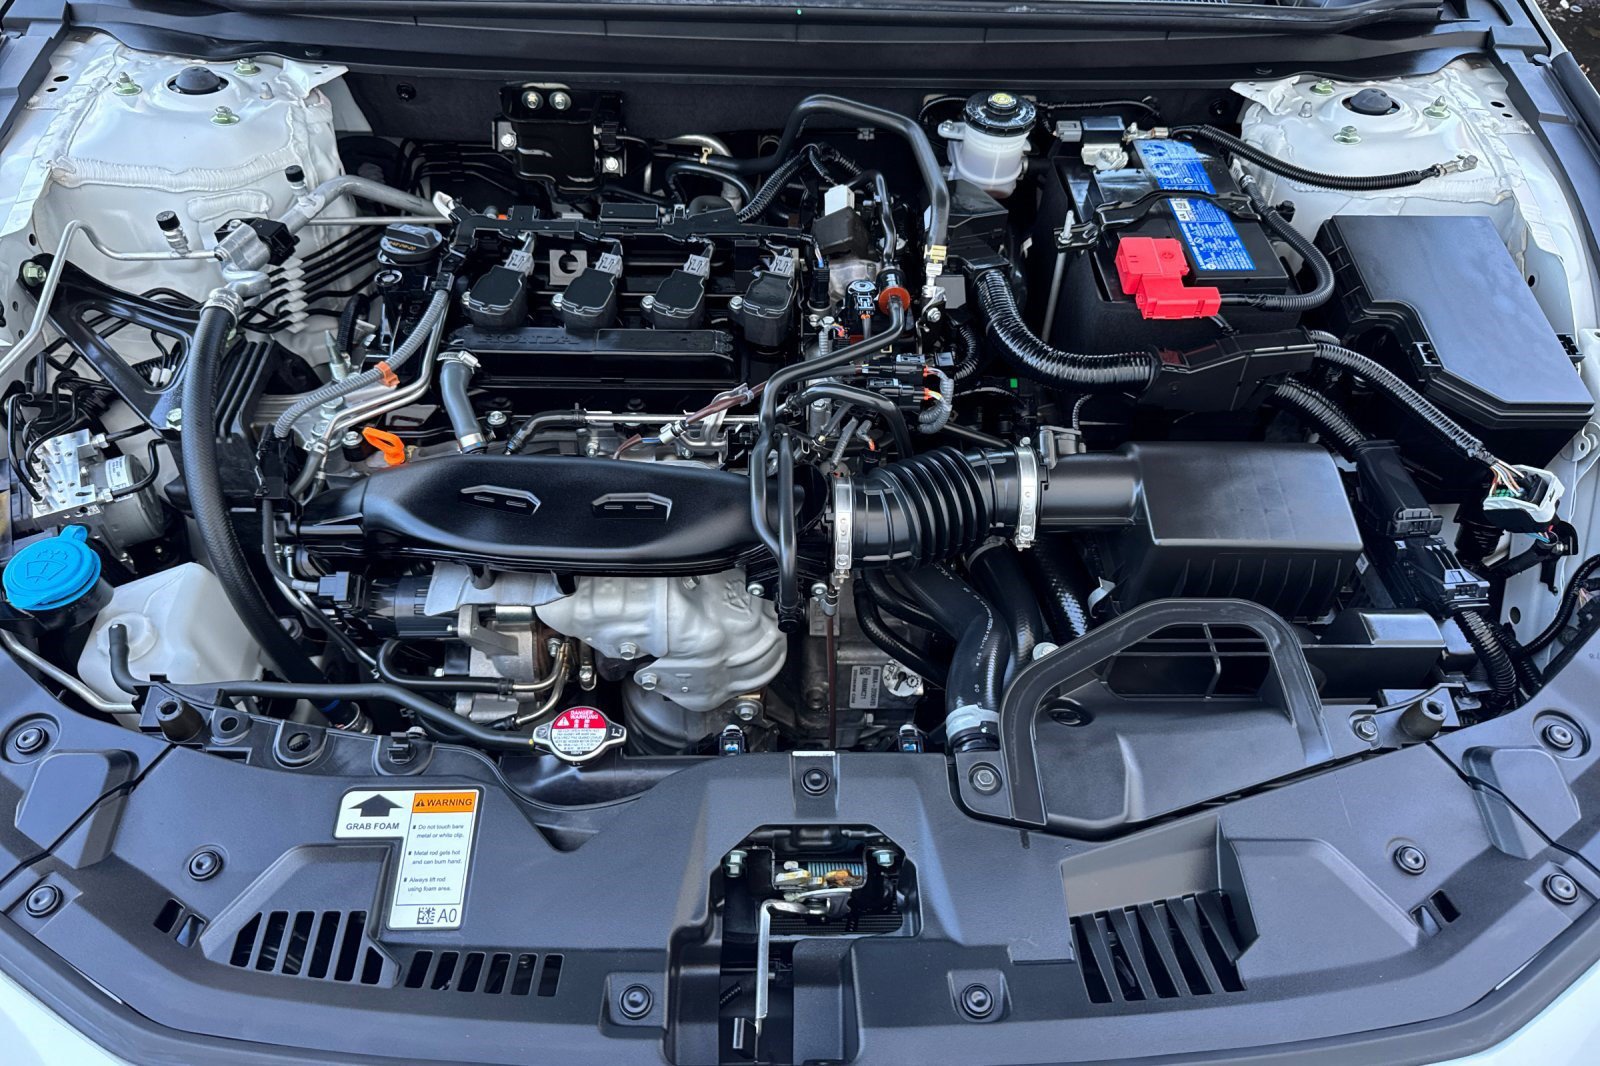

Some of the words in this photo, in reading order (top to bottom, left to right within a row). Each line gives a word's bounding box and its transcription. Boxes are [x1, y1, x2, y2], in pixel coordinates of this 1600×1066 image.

[478, 333, 582, 345] HONDA
[427, 798, 473, 807] WARNING
[346, 822, 372, 830] GRAB
[373, 822, 400, 830] FOAM
[437, 908, 458, 923] A0
